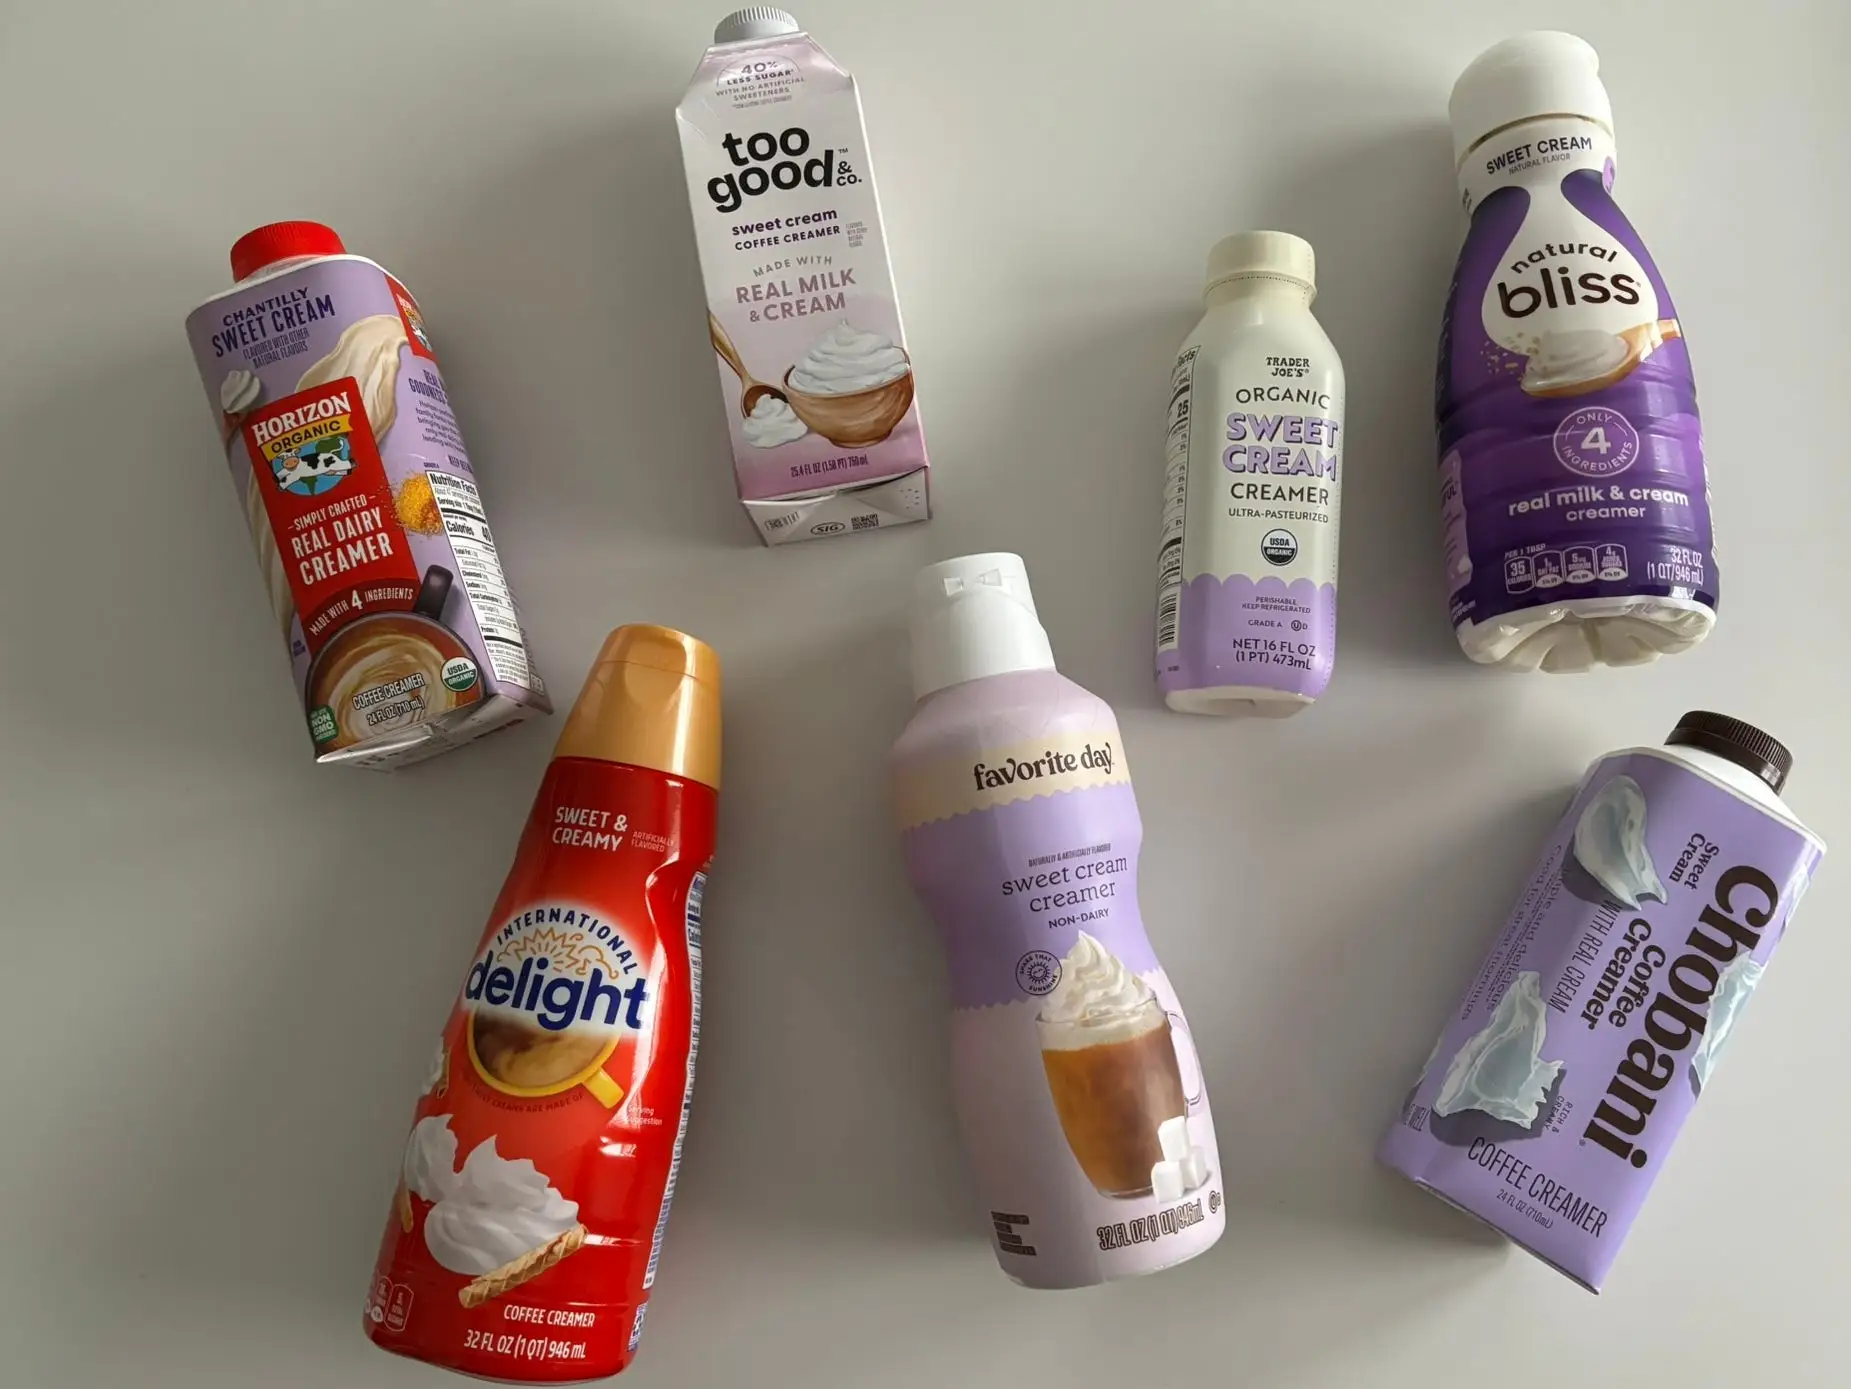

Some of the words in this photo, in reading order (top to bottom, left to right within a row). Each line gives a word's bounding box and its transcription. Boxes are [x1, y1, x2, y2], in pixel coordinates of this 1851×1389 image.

[727, 76, 751, 85] LESS
[741, 61, 779, 74] 40%
[715, 88, 739, 97] WITH
[758, 77, 804, 90] ARTIFICIAL
[733, 87, 790, 101] SWEETENERS
[722, 127, 810, 167] too
[1486, 144, 1532, 175] SWEET
[1537, 136, 1592, 154] CREAM
[837, 160, 852, 174] &
[1509, 160, 1541, 176] NATURAL
[1542, 153, 1571, 165] FLAVOR
[707, 150, 834, 214] good
[732, 218, 782, 236] sweet
[785, 210, 838, 227] cream
[735, 236, 780, 251] COFFEE
[783, 225, 841, 243] CREAMER
[752, 259, 791, 277] MADE
[796, 256, 832, 266] WITH
[1510, 243, 1618, 274] natural
[736, 280, 793, 304] REAL
[799, 268, 857, 294] MILK
[1497, 266, 1640, 319] bliss
[222, 287, 308, 326] CHANTILLY
[750, 310, 760, 322] &
[763, 292, 846, 321] CREAM
[212, 316, 267, 358] SWEET
[271, 294, 335, 332] CREAM
[242, 339, 273, 360] FLAVORED
[271, 335, 288, 350] WITH
[288, 327, 310, 343] OTHER
[252, 345, 281, 369] NATURAL
[280, 340, 308, 361] FLAVORS
[1266, 357, 1311, 367] TRADER
[1177, 399, 1189, 419] 25
[1236, 386, 1330, 409] ORGANIC
[251, 391, 352, 447] HORIZON
[1226, 412, 1338, 448] SWEET
[1576, 412, 1613, 425] ONLY
[271, 420, 340, 453] ORGANIC
[1581, 427, 1611, 455] 4
[791, 466, 804, 478] 25.4
[804, 464, 812, 476] FL
[813, 463, 822, 474] OZ
[848, 456, 859, 468] 750
[1222, 444, 1337, 482] CREAM
[1562, 441, 1632, 472] INGREDIENTS
[429, 473, 462, 490] Nutrition
[461, 481, 477, 496] Facts
[1230, 483, 1329, 505] CREAMER
[294, 508, 328, 531] SIMPLY
[328, 494, 367, 517] CRAFTED
[1509, 495, 1550, 516] real
[1556, 486, 1604, 506] milk
[1610, 486, 1625, 500] &
[1629, 488, 1689, 506] cream
[1566, 506, 1646, 522] creamer
[446, 520, 475, 536] Calories
[817, 525, 839, 533] SIG
[1228, 508, 1329, 524] ULTRA-PASTEURIZED
[291, 527, 331, 559] REAL
[333, 506, 383, 542] DAIRY
[1269, 538, 1290, 547] USDA
[299, 532, 394, 585] CREAMER
[1266, 548, 1294, 557] ORGANIC
[1671, 547, 1682, 563] 32
[1682, 548, 1692, 565] FL
[1693, 551, 1703, 568] OZ
[1511, 561, 1525, 576] 35
[1647, 561, 1656, 580] (1
[309, 613, 330, 636] MADE
[328, 600, 349, 619] WITH
[351, 590, 362, 610] 4
[364, 588, 414, 603] INGREDIENTS
[1256, 596, 1296, 606] PERISHABLE
[1261, 604, 1311, 614] REFRIGERATED
[1248, 620, 1275, 628] GRADE
[1233, 639, 1260, 650] NET
[1263, 640, 1277, 651] 16
[1280, 641, 1295, 653] FL
[1298, 644, 1316, 656] OZ
[1236, 650, 1245, 663] (1
[1249, 651, 1269, 664] PT)
[1272, 654, 1312, 670] 473mL
[447, 663, 469, 675] USDA
[448, 671, 475, 686] ORGANIC
[352, 687, 385, 710] COFFEE
[384, 673, 425, 698] CREAMER
[312, 712, 332, 726] NON
[367, 713, 377, 726] 24
[376, 710, 386, 722] FL
[386, 705, 395, 718] OZ
[395, 700, 411, 715] (710
[313, 722, 334, 736] GMO
[974, 751, 1078, 791] favorite
[1081, 742, 1112, 775] day
[555, 806, 611, 829] SWEET
[613, 814, 628, 832] &
[552, 827, 623, 852] CREAMY
[631, 839, 665, 853] FLAVORED
[633, 831, 675, 847] ARTIFICIALLY
[1669, 833, 1705, 883] Cream
[1684, 842, 1720, 890] Sweet
[1001, 866, 1070, 896] sweet
[1075, 857, 1128, 880] cream
[1029, 882, 1116, 912] creamer
[1048, 908, 1109, 929] NON-DAIRY
[1589, 899, 1621, 936] WITH
[496, 908, 638, 975] INTERNATIONAL
[1572, 931, 1603, 966] REAL
[1581, 918, 1651, 1030] Creamer
[1608, 944, 1666, 1028] Coffee
[465, 950, 650, 1031] delight
[1548, 966, 1585, 1013] CREAM
[1583, 865, 1779, 1168] Chobani
[1559, 1101, 1573, 1125] RICH
[1467, 1136, 1532, 1191] COFFEE
[1528, 1172, 1608, 1238] CREAMER
[1496, 1189, 1508, 1201] 24
[1507, 1194, 1516, 1208] FL
[1515, 1200, 1527, 1213] OZ
[1096, 1225, 1116, 1251] 32
[1113, 1222, 1132, 1248] FL
[1129, 1217, 1148, 1244] OZ
[1147, 1214, 1160, 1242] (1
[1159, 1207, 1178, 1235] QT)
[503, 1305, 546, 1325] COFFEE
[547, 1310, 595, 1328] CREAMER
[464, 1329, 482, 1348] 32
[481, 1333, 494, 1352] FL
[497, 1335, 514, 1354] OZ
[514, 1335, 527, 1359] (1
[527, 1336, 548, 1361] QT)
[548, 1340, 571, 1358] 946
[570, 1342, 587, 1359] mL
